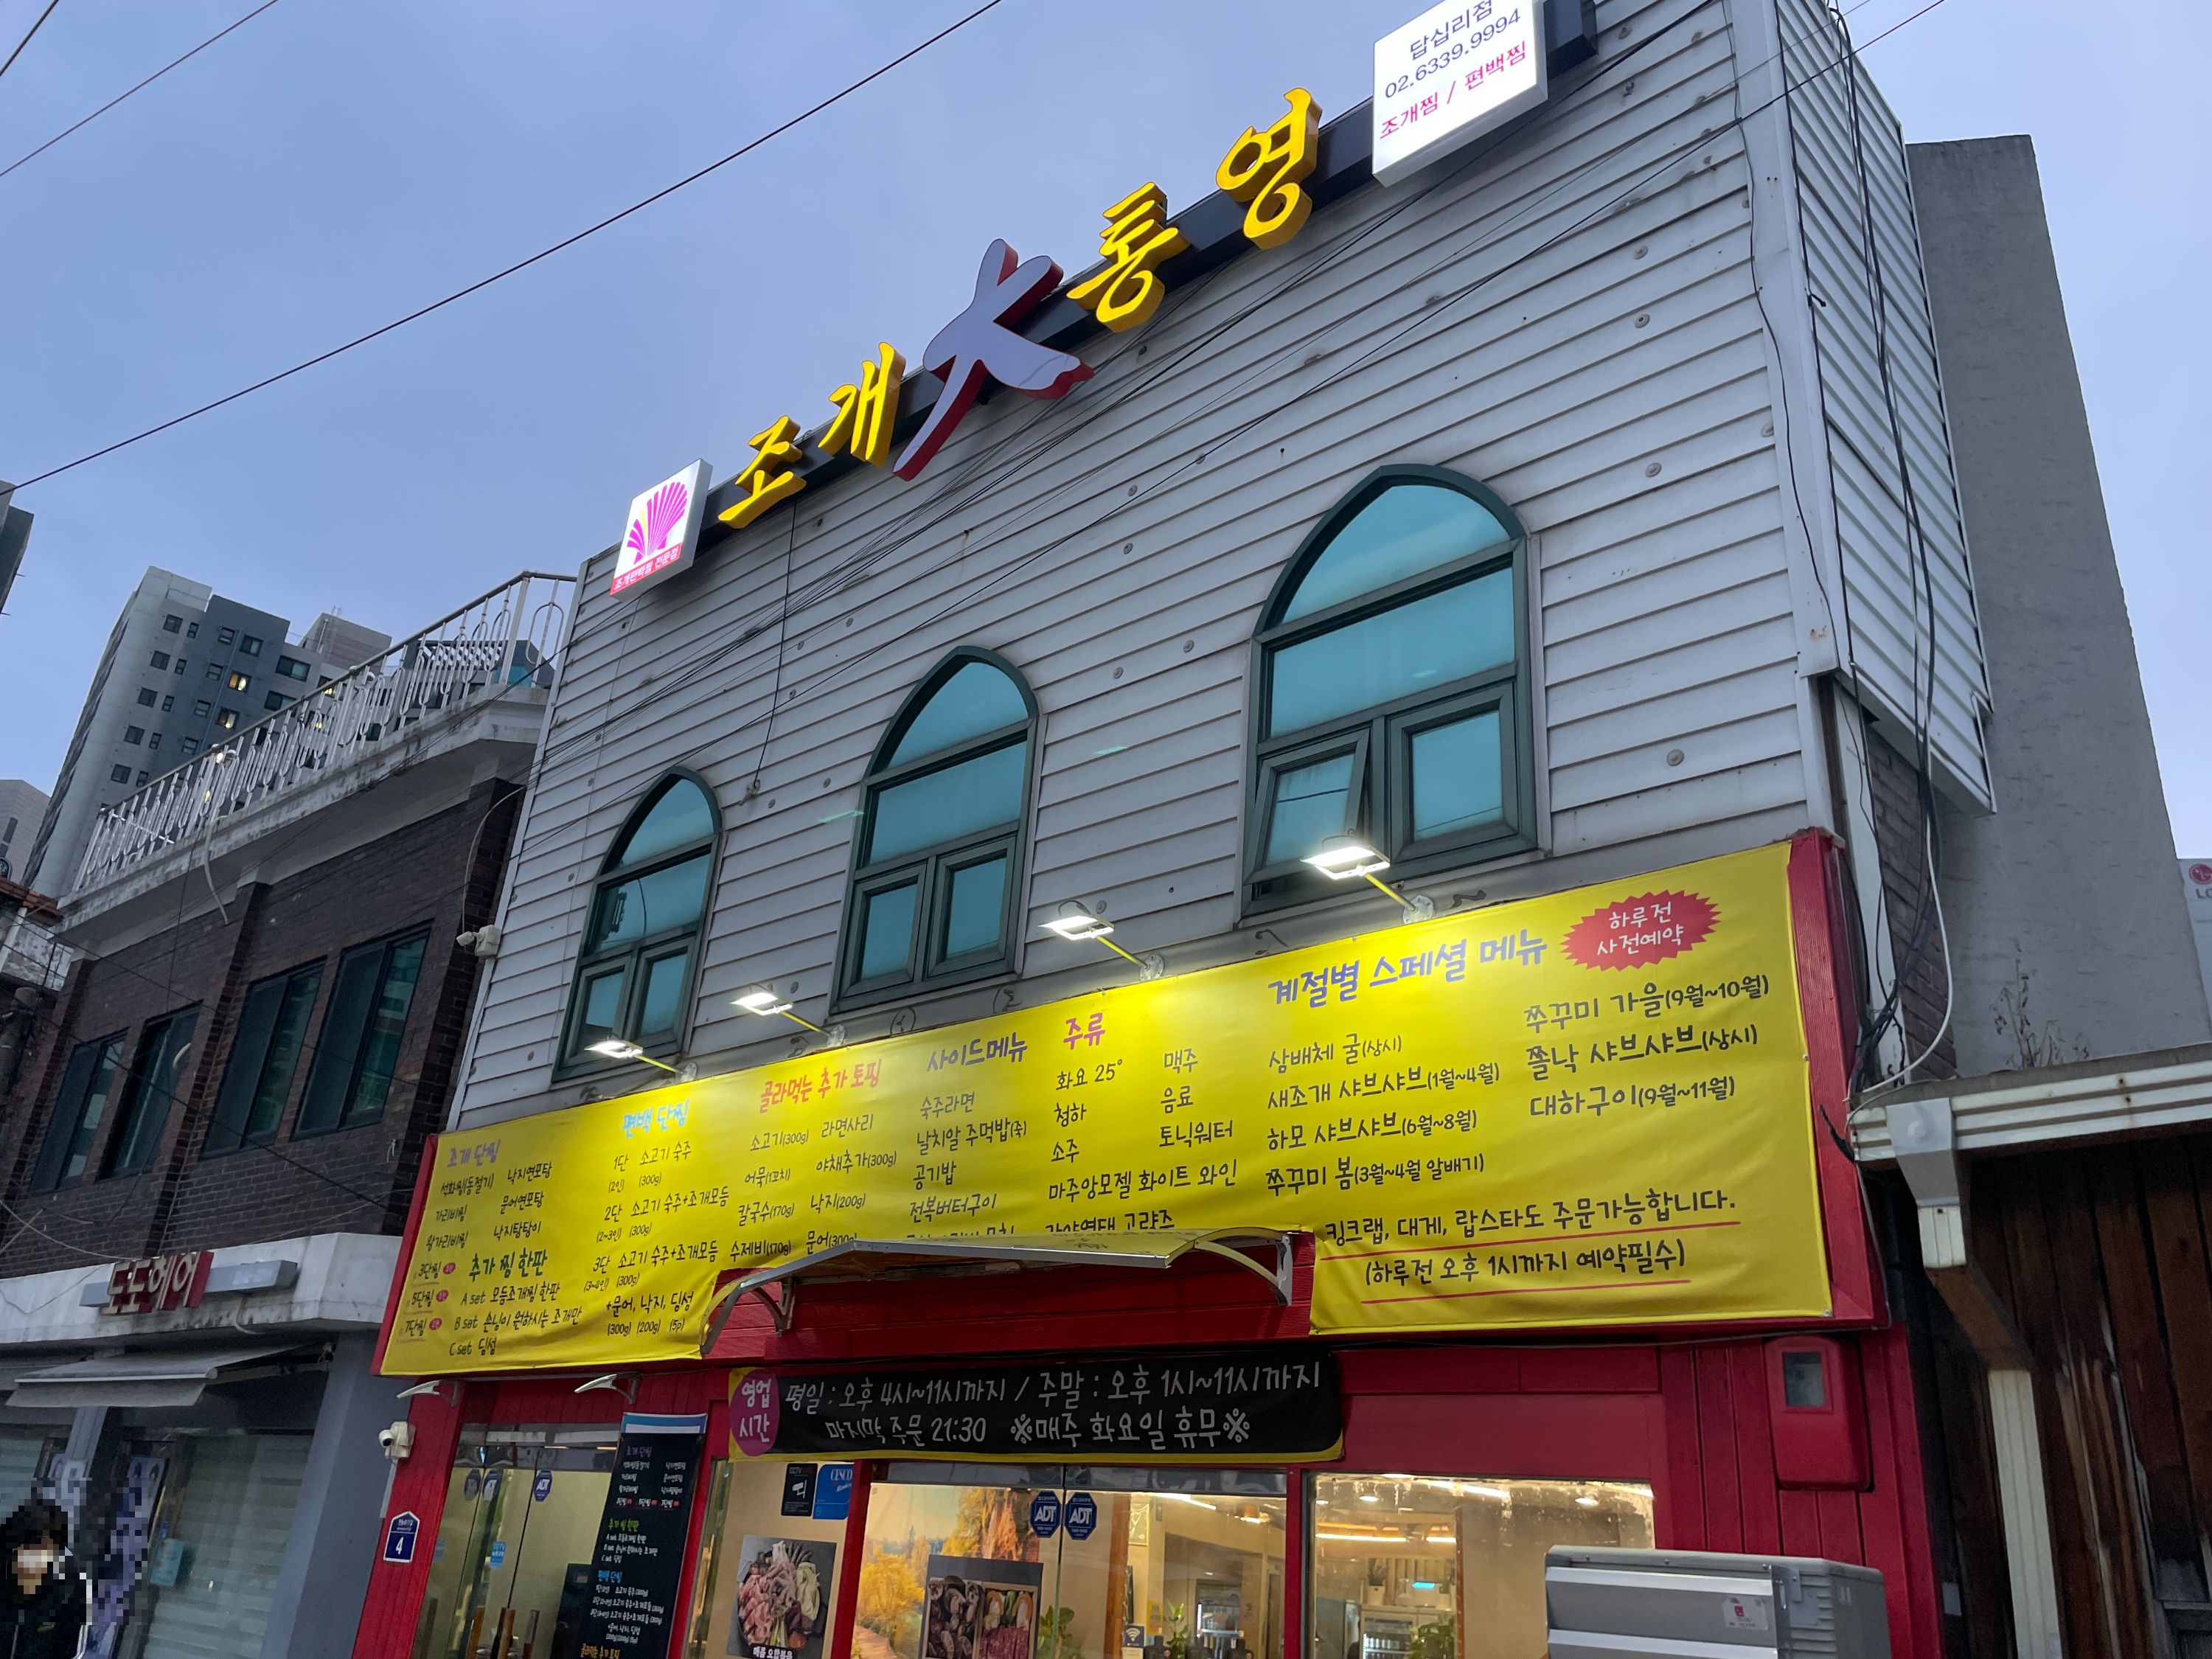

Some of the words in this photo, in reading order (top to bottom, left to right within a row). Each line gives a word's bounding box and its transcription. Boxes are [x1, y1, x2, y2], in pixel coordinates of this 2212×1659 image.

[1410, 0, 1492, 61] 답십리점
[1385, 7, 1521, 99] 02.6339.9994
[1380, 91, 1438, 139] 조개찜
[1464, 41, 1526, 91] 편백찜
[655, 546, 678, 569] 전문점
[1596, 924, 1684, 956] 사전예약
[1267, 959, 1360, 1008] 계절별
[1368, 938, 1467, 983] 스페셜
[1479, 929, 1547, 966] 메뉴
[1063, 1012, 1105, 1050] 주류
[1524, 998, 1599, 1034] 쭈꾸미
[927, 1032, 1028, 1072] 사이드메뉴
[1164, 1048, 1199, 1074] 맥주
[1269, 1041, 1334, 1074] 삼배체
[1526, 1043, 1579, 1081] 쫄낙
[759, 1074, 813, 1114] 골라먹는
[818, 1066, 848, 1099] 추가
[850, 1058, 882, 1088] 토핑
[1056, 1067, 1088, 1091] 화요
[920, 1091, 975, 1121] 숙주라면
[1161, 1085, 1194, 1113] 음료
[1267, 1083, 1331, 1109] 새조개
[622, 1107, 653, 1138] 편백
[821, 1113, 874, 1138] 라면사리
[1054, 1102, 1087, 1127] 청하
[917, 1125, 961, 1155] 날치알
[1158, 1119, 1233, 1148] 토닉워터
[1267, 1125, 1306, 1150] 하모
[447, 1147, 472, 1168] 조개
[613, 1153, 629, 1172] 1단
[639, 1147, 670, 1166] 소고기
[673, 1141, 692, 1162] 숙주
[1051, 1138, 1079, 1164] 소주
[507, 1161, 552, 1184] 낙지연포탕
[913, 1161, 957, 1190] 공기밥
[1048, 1170, 1131, 1203] 마주앙모젤
[1138, 1165, 1191, 1192] 화이트
[1197, 1158, 1237, 1186] 와인
[1265, 1166, 1326, 1197] 쭈꾸미
[501, 1191, 545, 1214] 문어연포탕
[604, 1203, 623, 1222] 2단
[630, 1199, 661, 1217] 소고기
[910, 1193, 997, 1223] 전복버터구이
[1455, 1204, 1544, 1238] 랍스타도
[1553, 1187, 1736, 1229] 주문가능합니다.
[493, 1221, 542, 1241] 낙지탕탕이
[469, 1253, 495, 1282] 추가
[518, 1247, 549, 1277] 한판
[593, 1255, 611, 1274] 3단
[617, 1251, 648, 1269] 소고기
[1440, 1252, 1479, 1282] 오후
[1488, 1251, 1568, 1277] 1시까지
[1576, 1238, 1686, 1274] 예약필수)
[100, 1251, 205, 1316] 도도헤어
[539, 1281, 561, 1302] 한판
[671, 1291, 695, 1312] 딤섬
[483, 1311, 512, 1333] 손님이
[551, 1306, 582, 1326] 조개만
[740, 1377, 772, 1408] 영업
[785, 1382, 825, 1415] 평일
[839, 1377, 874, 1411] 오후
[1038, 1370, 1085, 1410] 주말
[1107, 1364, 1150, 1405] 오후
[740, 1413, 770, 1443] 시간
[825, 1416, 886, 1444] 마지막
[889, 1414, 925, 1447] 주문
[931, 1416, 987, 1443] 21:30
[1090, 1409, 1166, 1451] 화요일
[1034, 1506, 1057, 1523] ADT
[1068, 1507, 1093, 1525] ADT
[395, 1537, 404, 1555] 4
